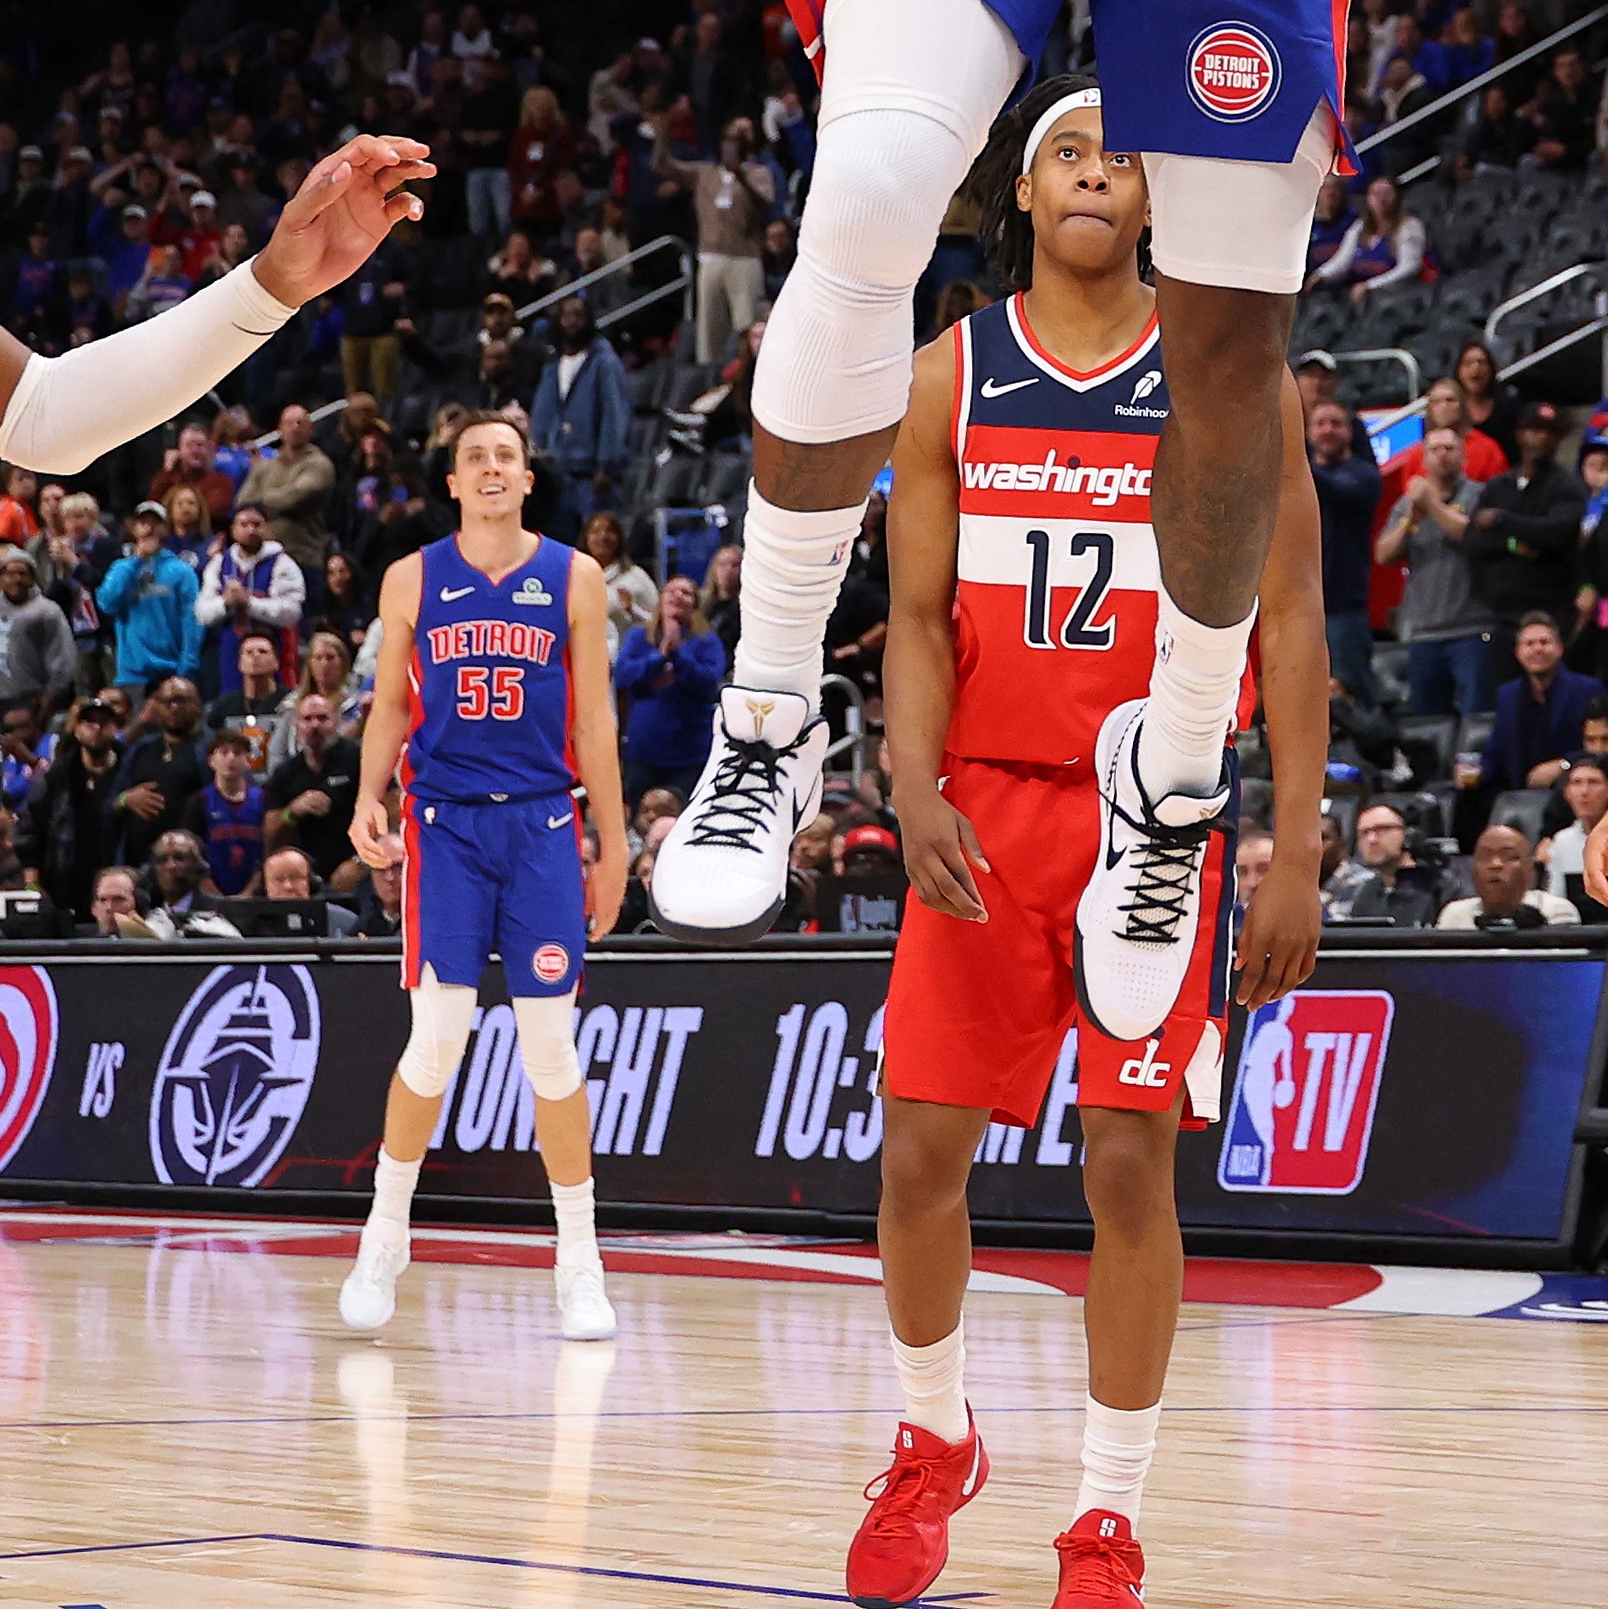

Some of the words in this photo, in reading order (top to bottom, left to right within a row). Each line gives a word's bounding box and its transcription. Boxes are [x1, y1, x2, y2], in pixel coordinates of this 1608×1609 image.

[1203, 54, 1261, 72] DETROIT
[1203, 69, 1260, 89] PISTONS
[1024, 529, 1116, 651] 12
[427, 620, 556, 667] DETROIT
[456, 666, 525, 721] 55
[79, 1042, 124, 1118] VS
[1293, 1031, 1374, 1152] TV
